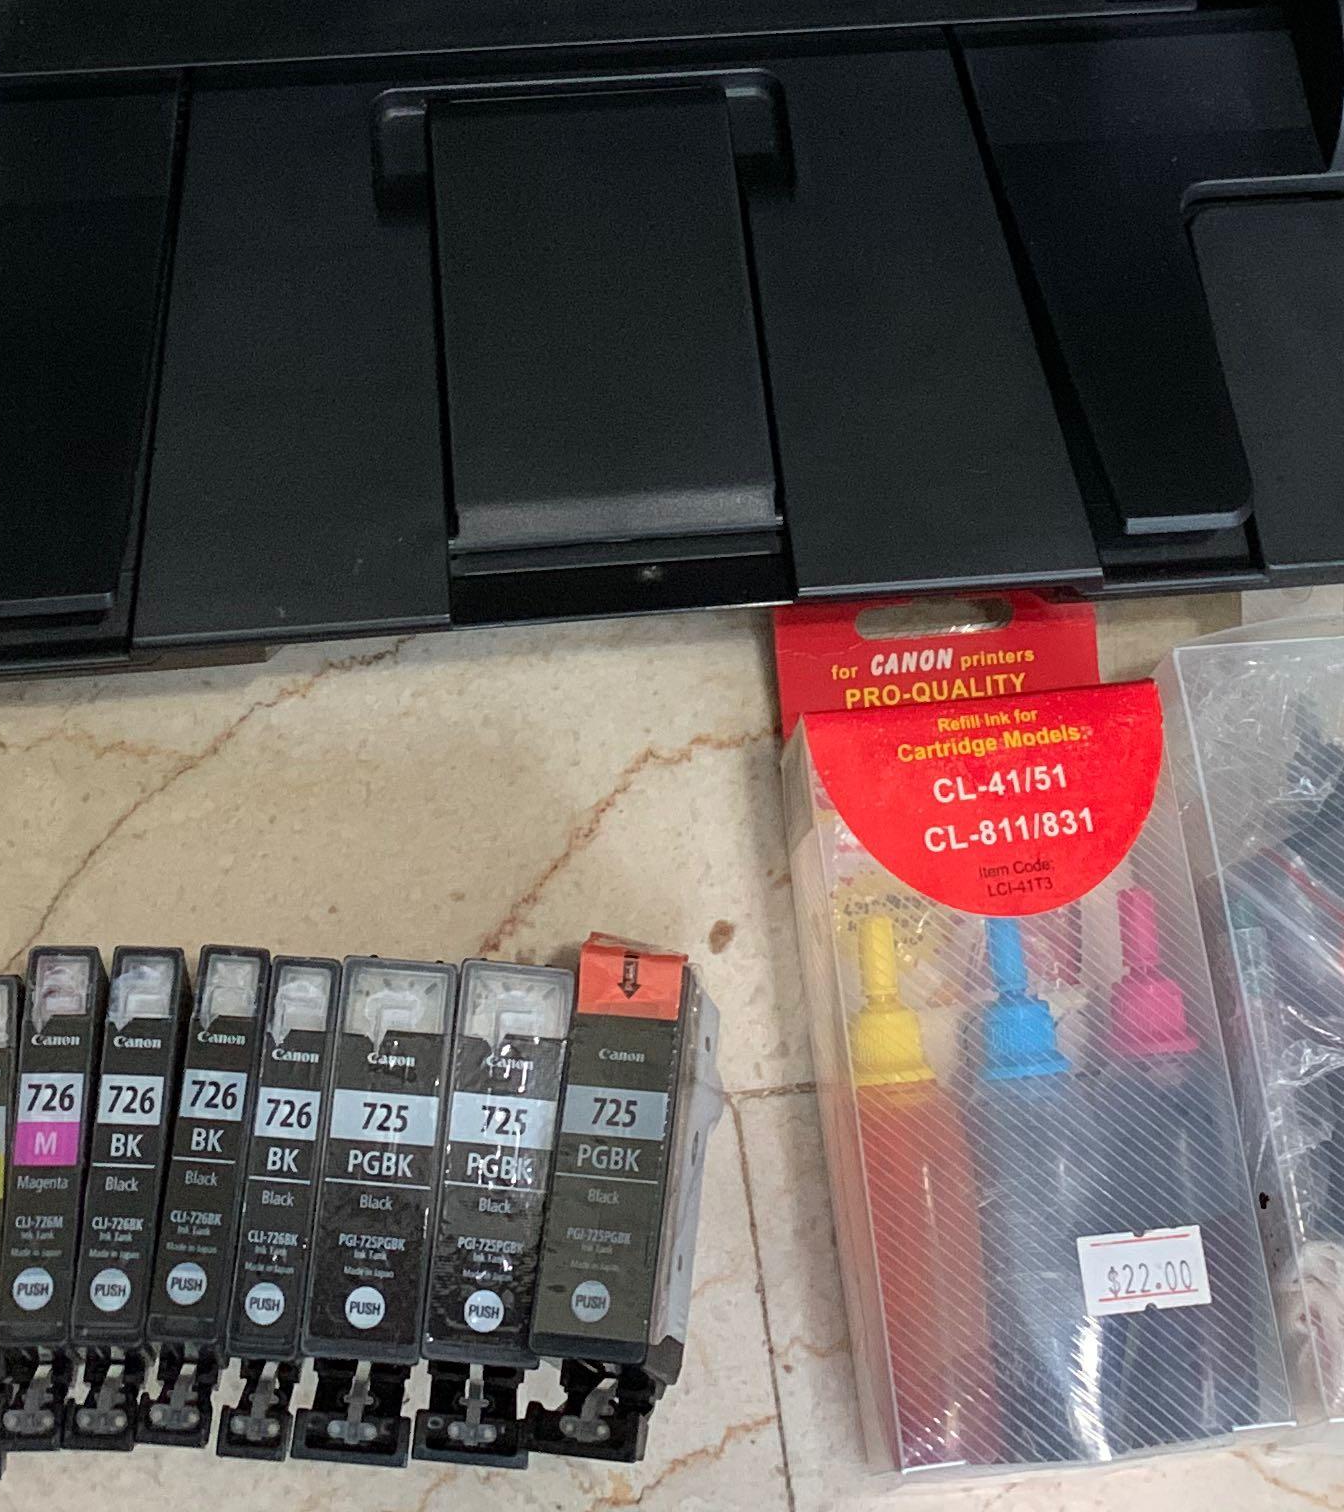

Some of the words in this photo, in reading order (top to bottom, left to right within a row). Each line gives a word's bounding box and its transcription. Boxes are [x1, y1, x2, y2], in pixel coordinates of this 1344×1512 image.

[831, 663, 858, 680] for
[869, 647, 954, 676] CANON
[960, 648, 1035, 671] printers
[845, 672, 1027, 710] PRO-QUALITY
[937, 715, 981, 733] Refill
[984, 713, 1010, 729] Ink
[1014, 709, 1037, 725] for
[897, 735, 998, 763] Cartridge
[933, 763, 1069, 804] CL-41/51
[924, 807, 1095, 854] CL-811/831
[979, 864, 1009, 879] Item
[1013, 858, 1055, 876] Code:
[31, 1034, 80, 1047] Canon
[113, 1035, 162, 1049] Canon
[197, 1030, 246, 1046] Canon
[271, 1048, 320, 1064] Canon
[367, 1052, 416, 1068] Canon
[486, 1054, 535, 1072] Canon
[598, 1048, 646, 1063] Canon
[27, 1083, 75, 1112] 726
[107, 1085, 156, 1114] 726
[190, 1080, 238, 1110] 726
[265, 1098, 313, 1129] 726
[361, 1101, 409, 1133] 725
[481, 1104, 528, 1136] 725
[591, 1096, 638, 1129] 725
[34, 1131, 57, 1155] M
[110, 1133, 144, 1158] BK
[190, 1127, 225, 1153] BK
[266, 1147, 300, 1173] BK
[347, 1149, 415, 1179] PGBK
[466, 1152, 533, 1182] PGBK
[576, 1143, 642, 1173] PGBK
[17, 1175, 69, 1191] Magenta
[106, 1177, 139, 1192] Black
[185, 1170, 218, 1186] Black
[261, 1190, 295, 1208] Black
[359, 1194, 393, 1211] Black
[478, 1197, 512, 1214] Black
[587, 1188, 620, 1205] Black
[16, 1282, 49, 1296] PUSH
[170, 1276, 203, 1291] PUSH
[1108, 1260, 1192, 1298] $22.00
[93, 1283, 126, 1297] PUSH
[248, 1296, 281, 1312] PUSH
[349, 1300, 382, 1317] PUSH
[468, 1304, 500, 1319] PUSH
[574, 1293, 606, 1310] PUSH
